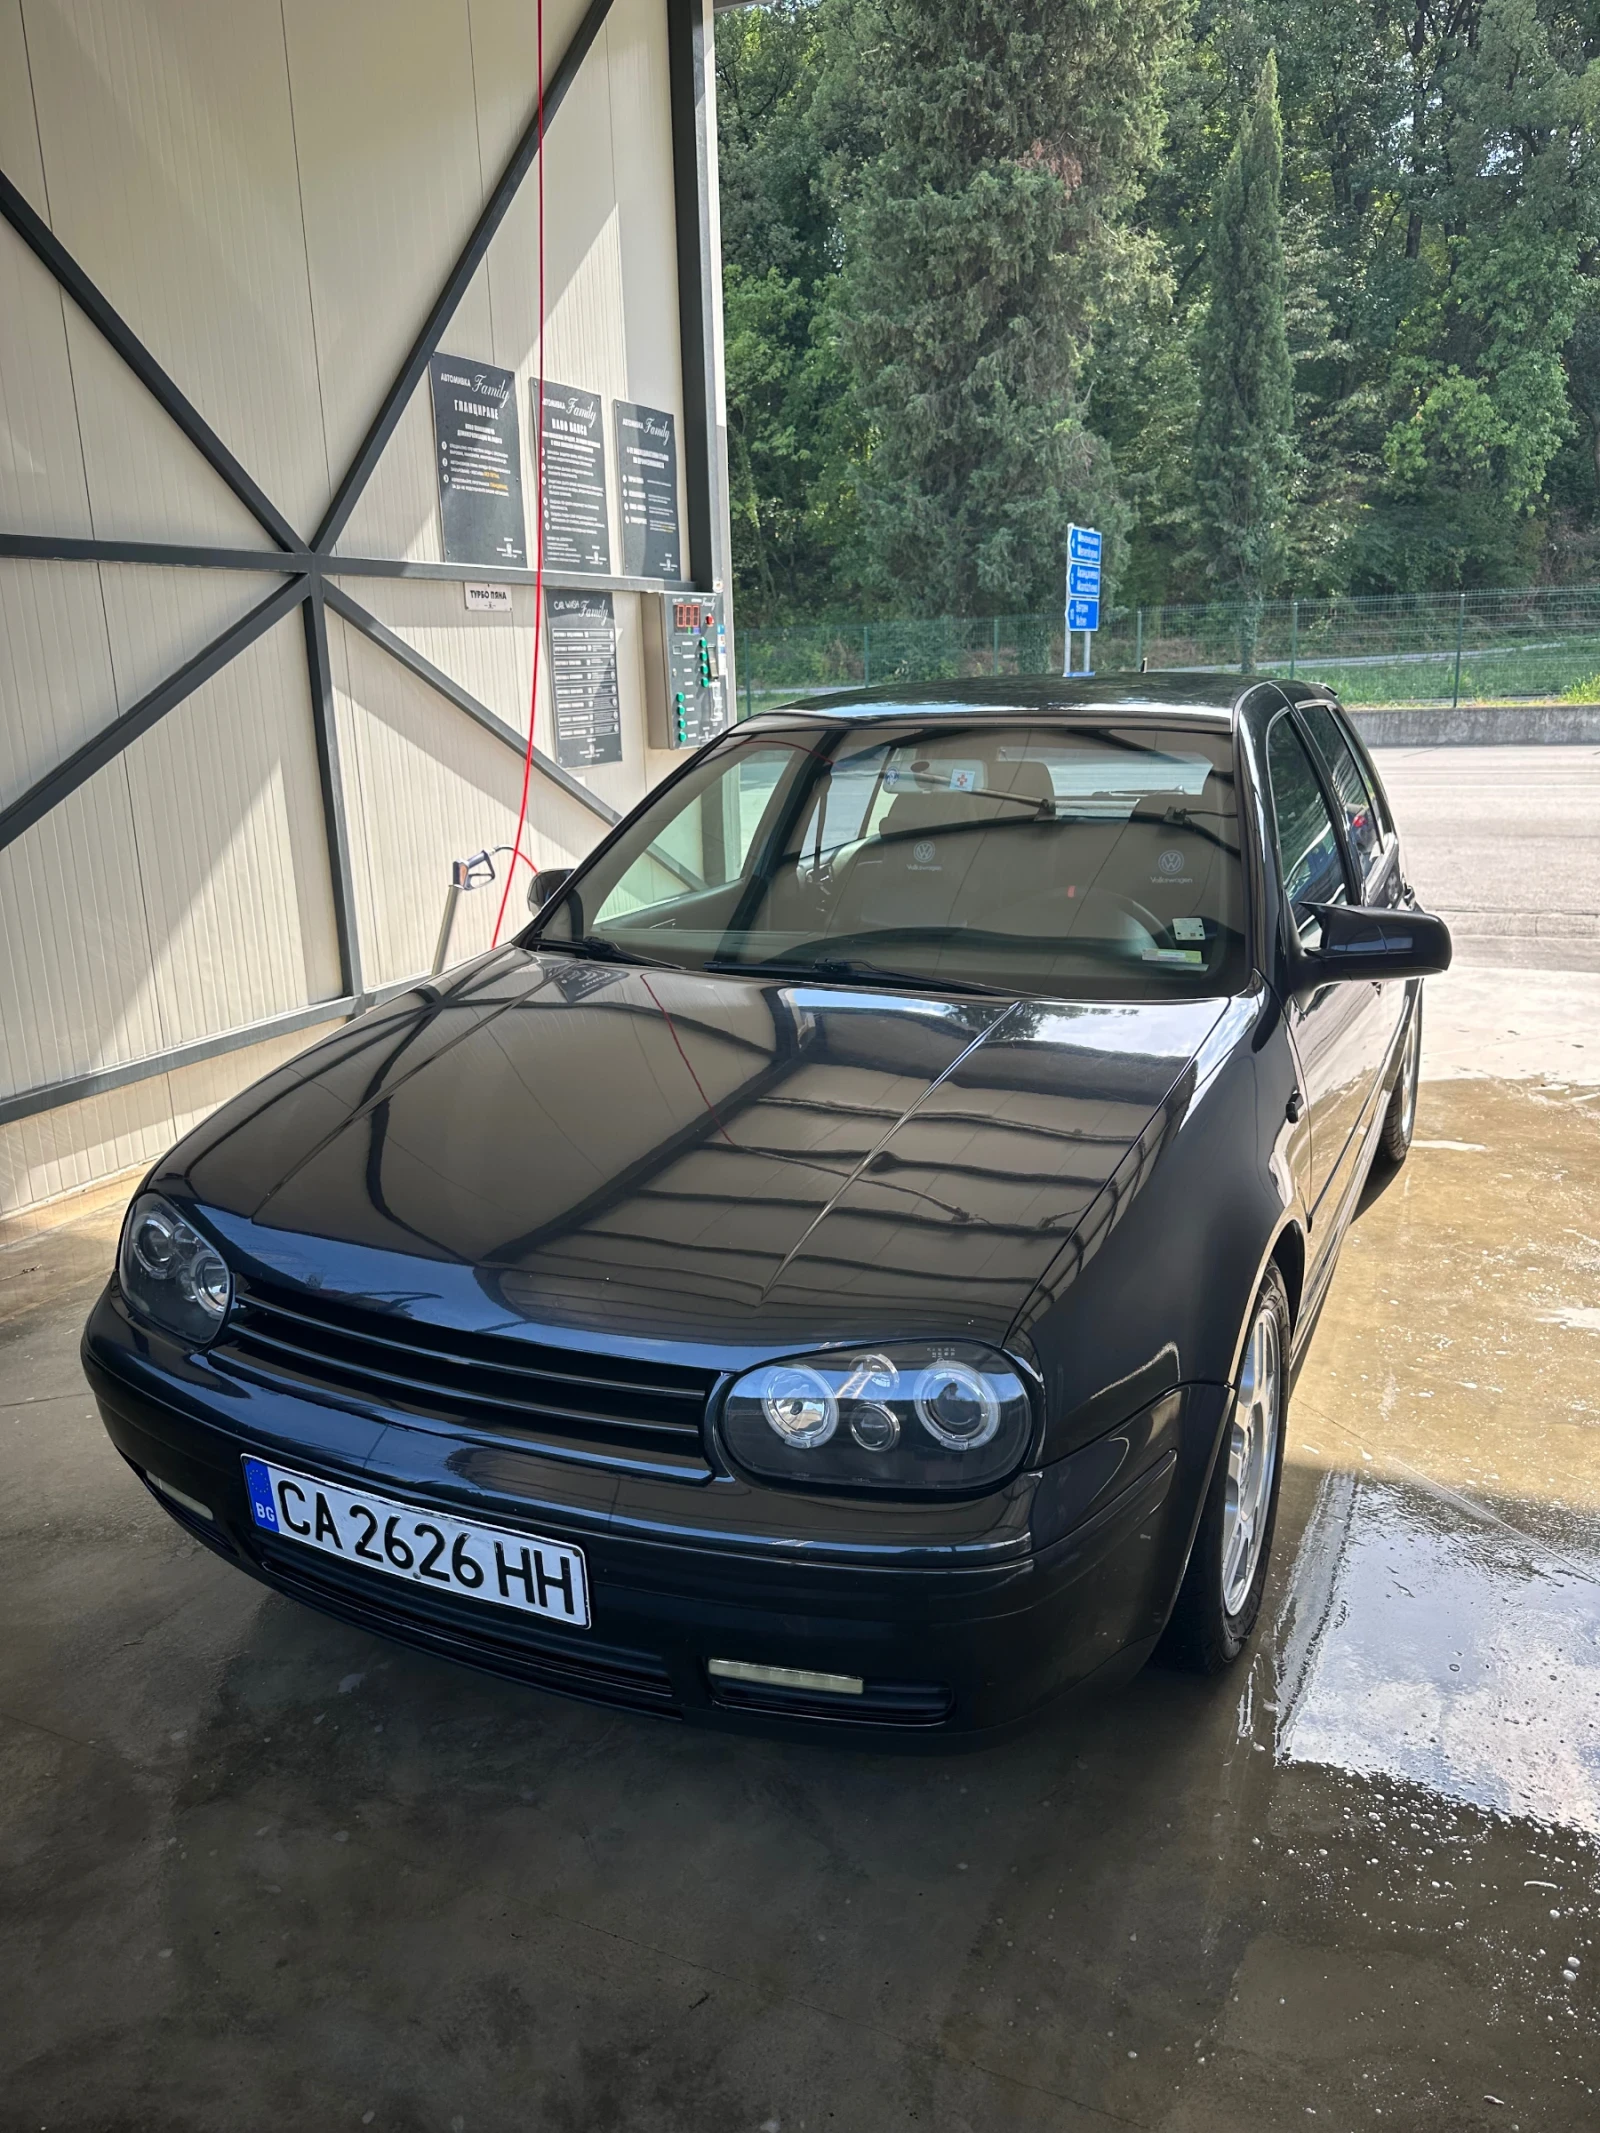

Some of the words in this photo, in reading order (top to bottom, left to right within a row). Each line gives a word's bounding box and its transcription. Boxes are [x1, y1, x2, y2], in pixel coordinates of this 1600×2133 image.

[471, 374, 509, 409] Family
[565, 397, 597, 429] Family
[643, 417, 670, 446] Family
[470, 589, 490, 599] ТУРБО
[490, 590, 507, 600] ПЯНА
[578, 599, 609, 627] Family
[255, 1501, 276, 1523] BG
[277, 1479, 344, 1551] CA
[349, 1504, 485, 1589] 2626
[493, 1540, 575, 1616] HH
